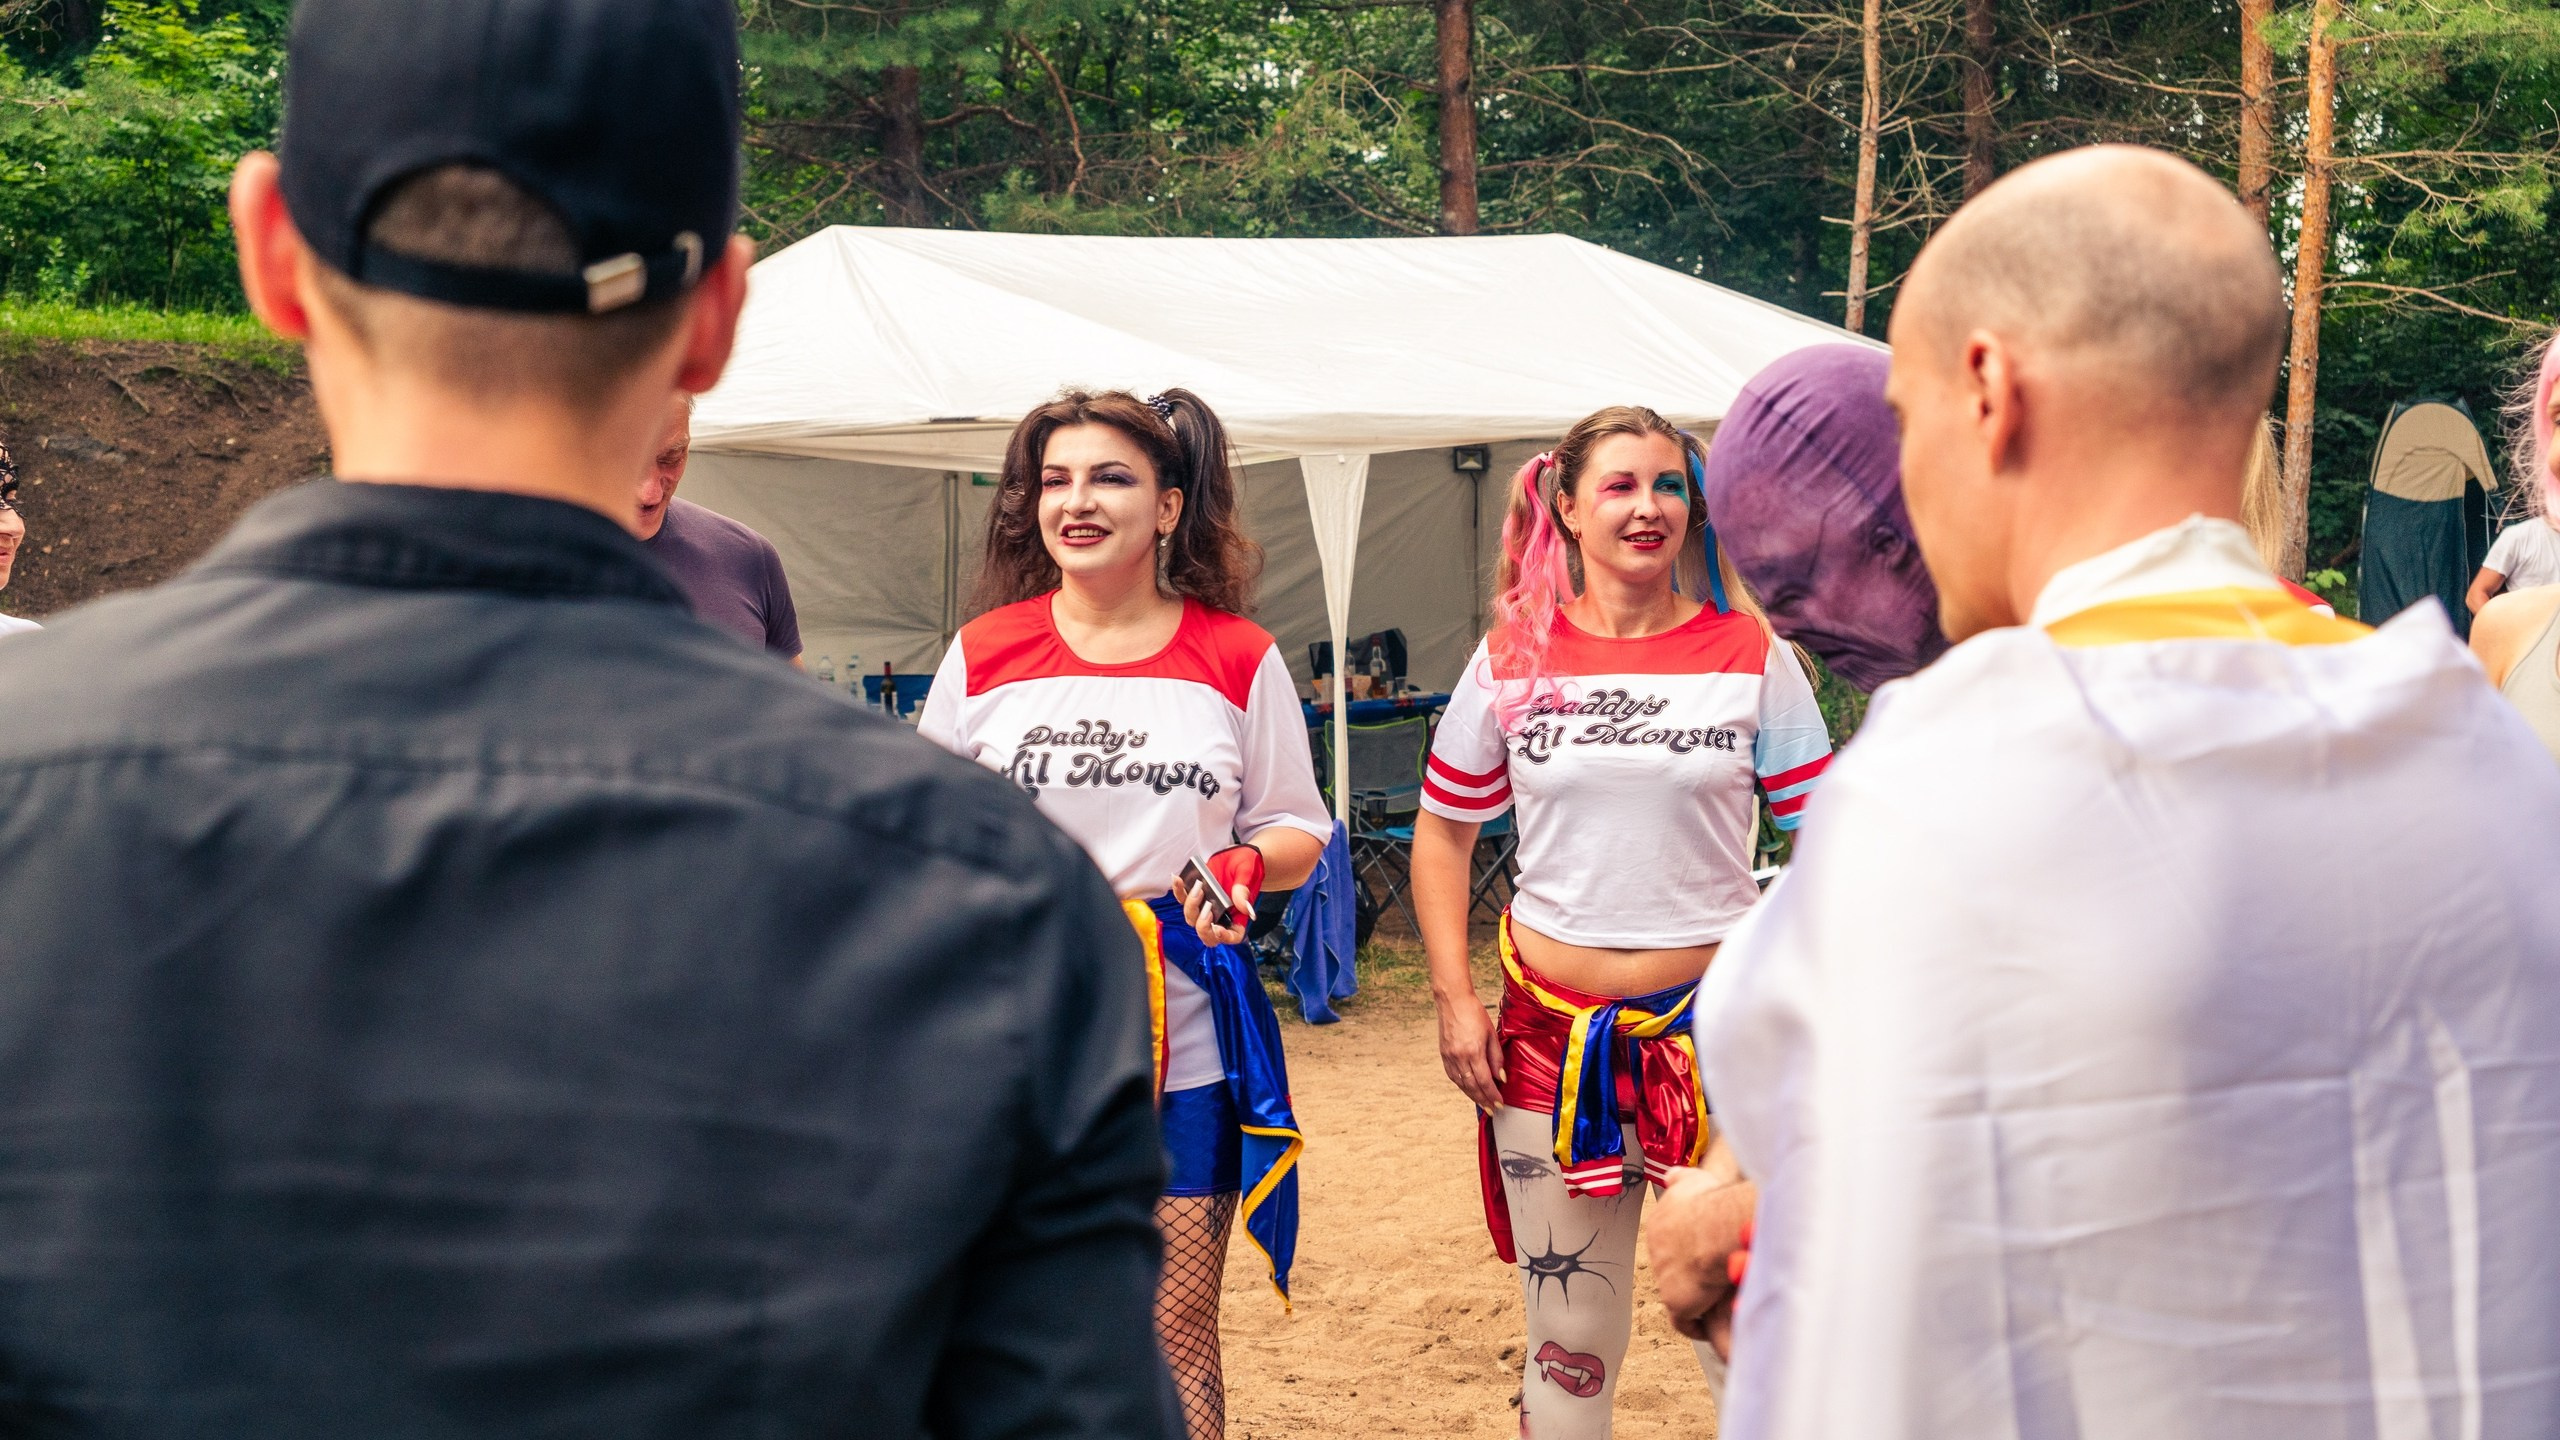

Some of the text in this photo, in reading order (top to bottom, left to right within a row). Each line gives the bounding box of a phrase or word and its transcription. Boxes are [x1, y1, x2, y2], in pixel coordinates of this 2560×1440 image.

[1526, 688, 1670, 724] Daddy's
[1017, 719, 1149, 753] Daddy's
[1510, 720, 1737, 765] Lil Monster
[1064, 752, 1221, 800] Monster
